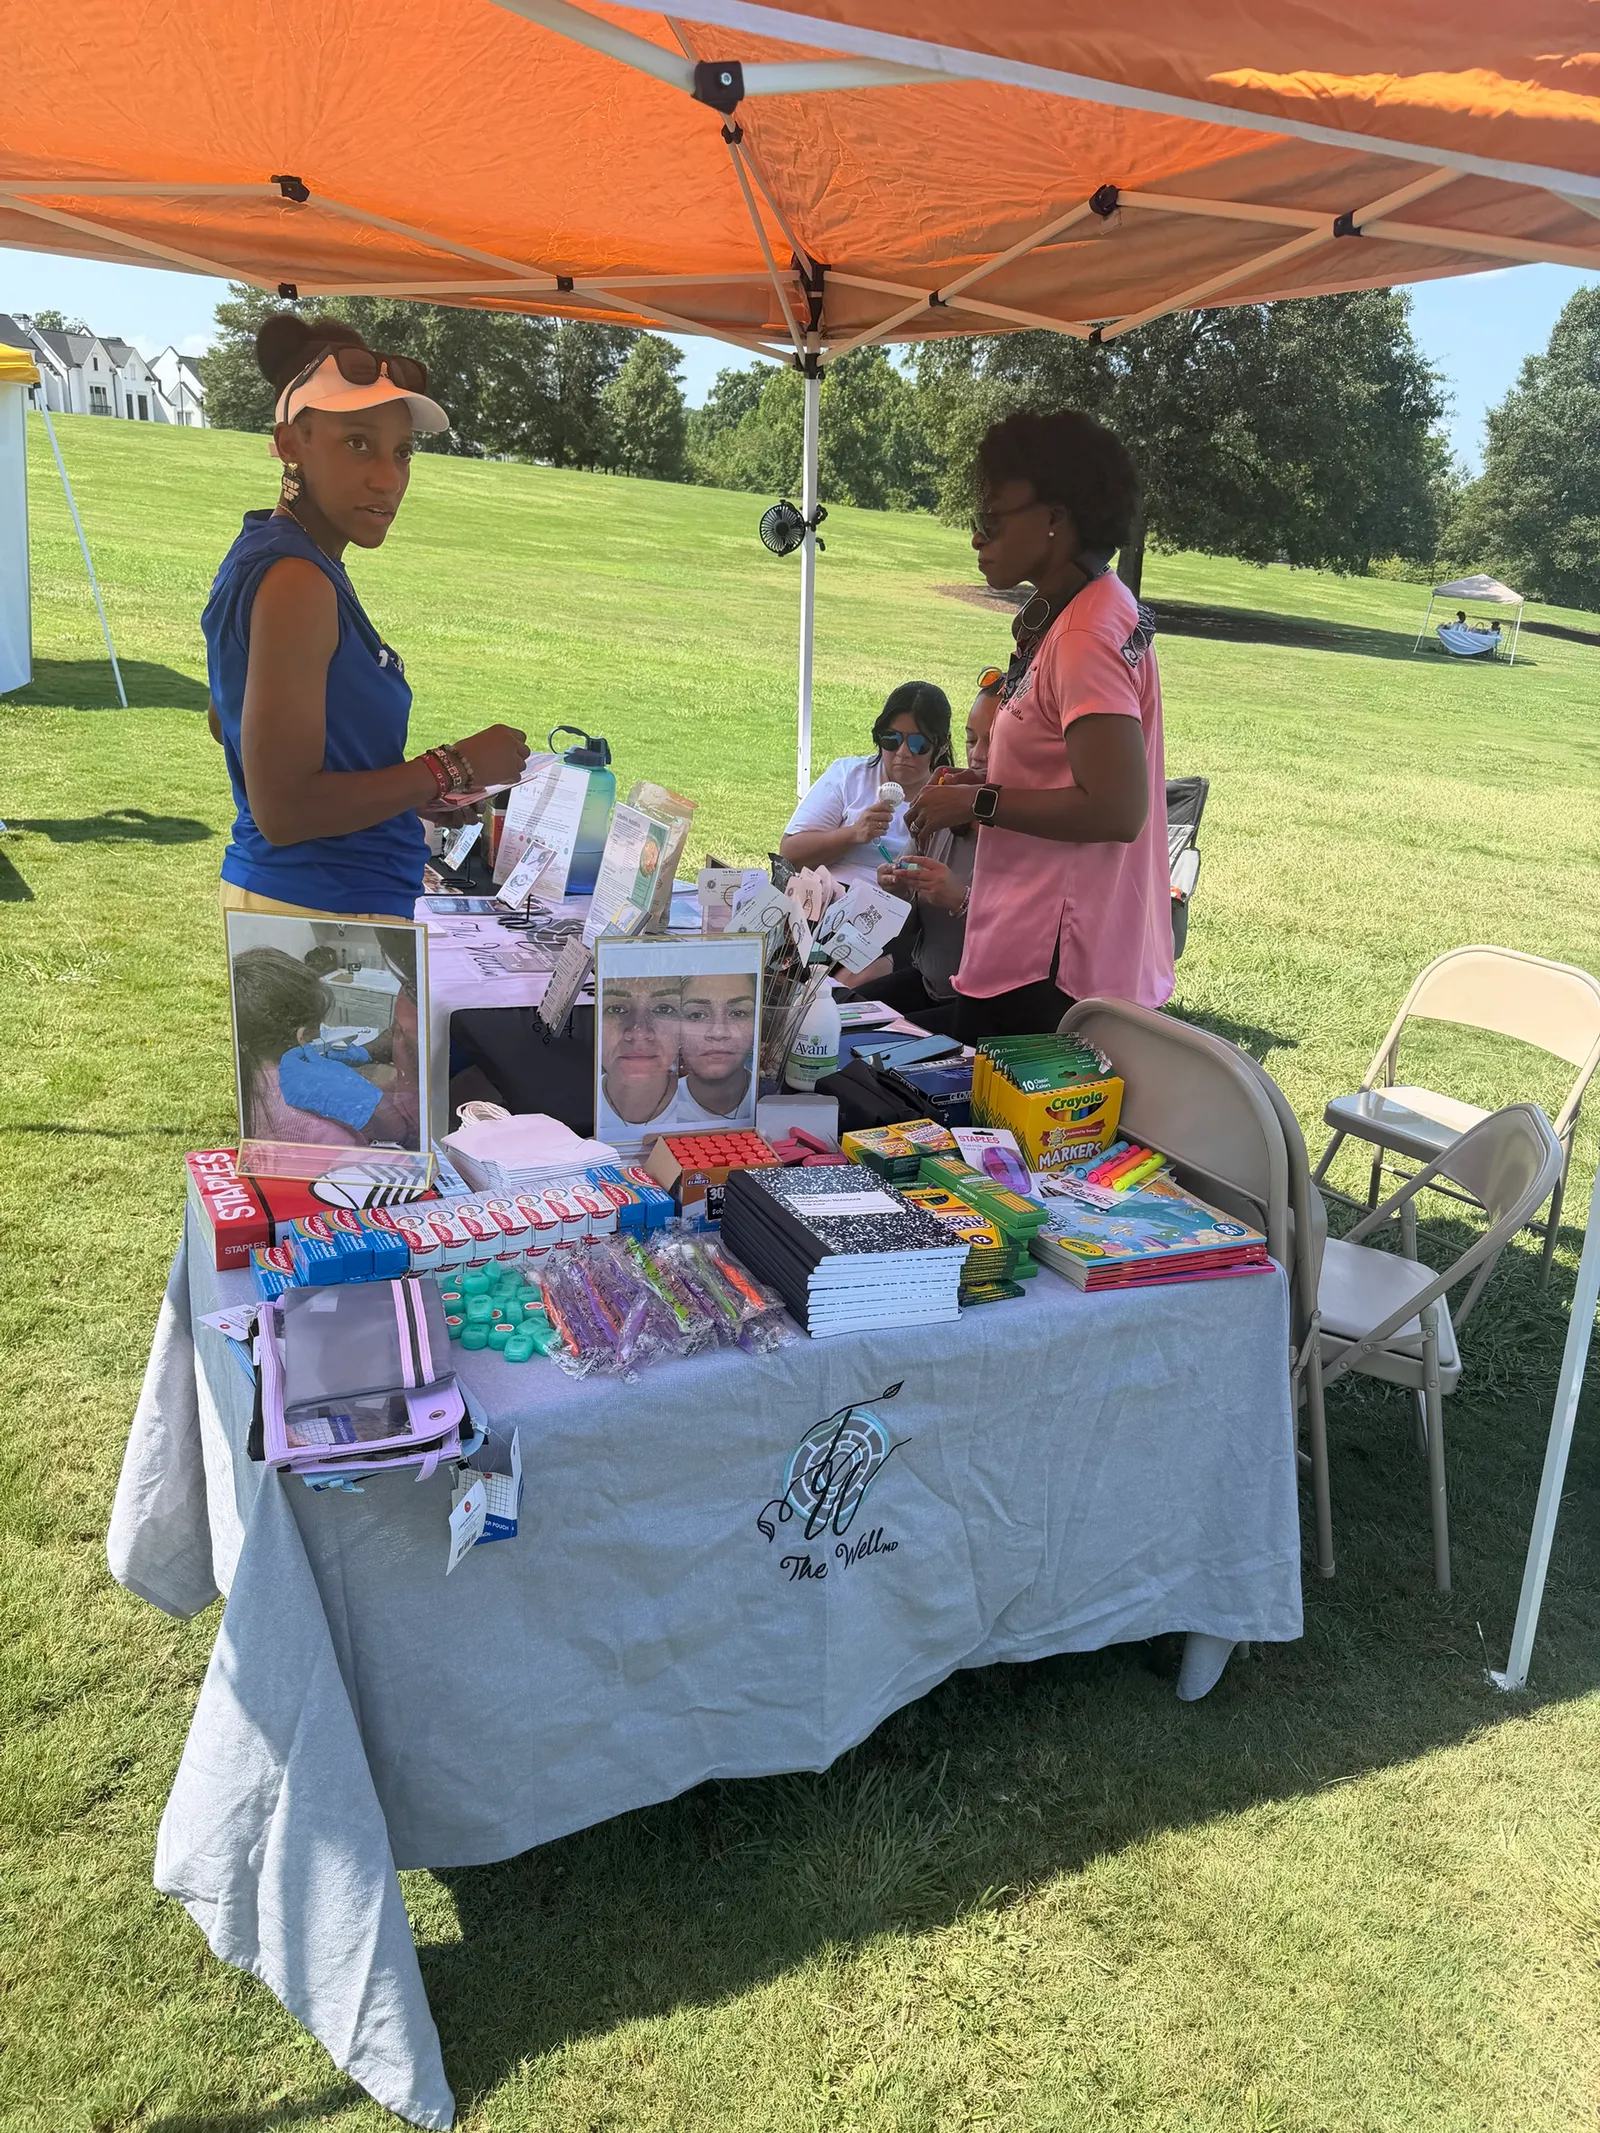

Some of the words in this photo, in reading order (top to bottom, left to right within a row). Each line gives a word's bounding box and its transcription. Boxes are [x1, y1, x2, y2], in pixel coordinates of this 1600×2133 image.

[794, 1042, 828, 1055] Avant
[978, 1044, 989, 1053] 10
[1022, 1079, 1034, 1092] 10
[1051, 1090, 1104, 1111] Crayola
[959, 1135, 1000, 1144] STAPLES
[1038, 1142, 1102, 1170] MARKERS
[635, 1166, 653, 1184] Colgate
[195, 1152, 257, 1221] STAPLES
[605, 1184, 625, 1204] Colgate
[709, 1187, 725, 1200] 30
[551, 1200, 566, 1216] Colgate
[580, 1196, 596, 1212] Colgate
[341, 1209, 357, 1230] Colgate
[375, 1208, 391, 1227] Colgate
[494, 1212, 509, 1229] Colgate
[523, 1207, 539, 1223] Colgate
[313, 1215, 329, 1237] Colgate
[435, 1224, 450, 1241] Colgate
[465, 1218, 480, 1234] Colgate
[404, 1230, 418, 1248] Colgate
[445, 1239, 467, 1247] Colgate
[224, 1241, 267, 1255] STAPLES
[272, 1247, 291, 1269] Colgate
[780, 1555, 828, 1581] The
